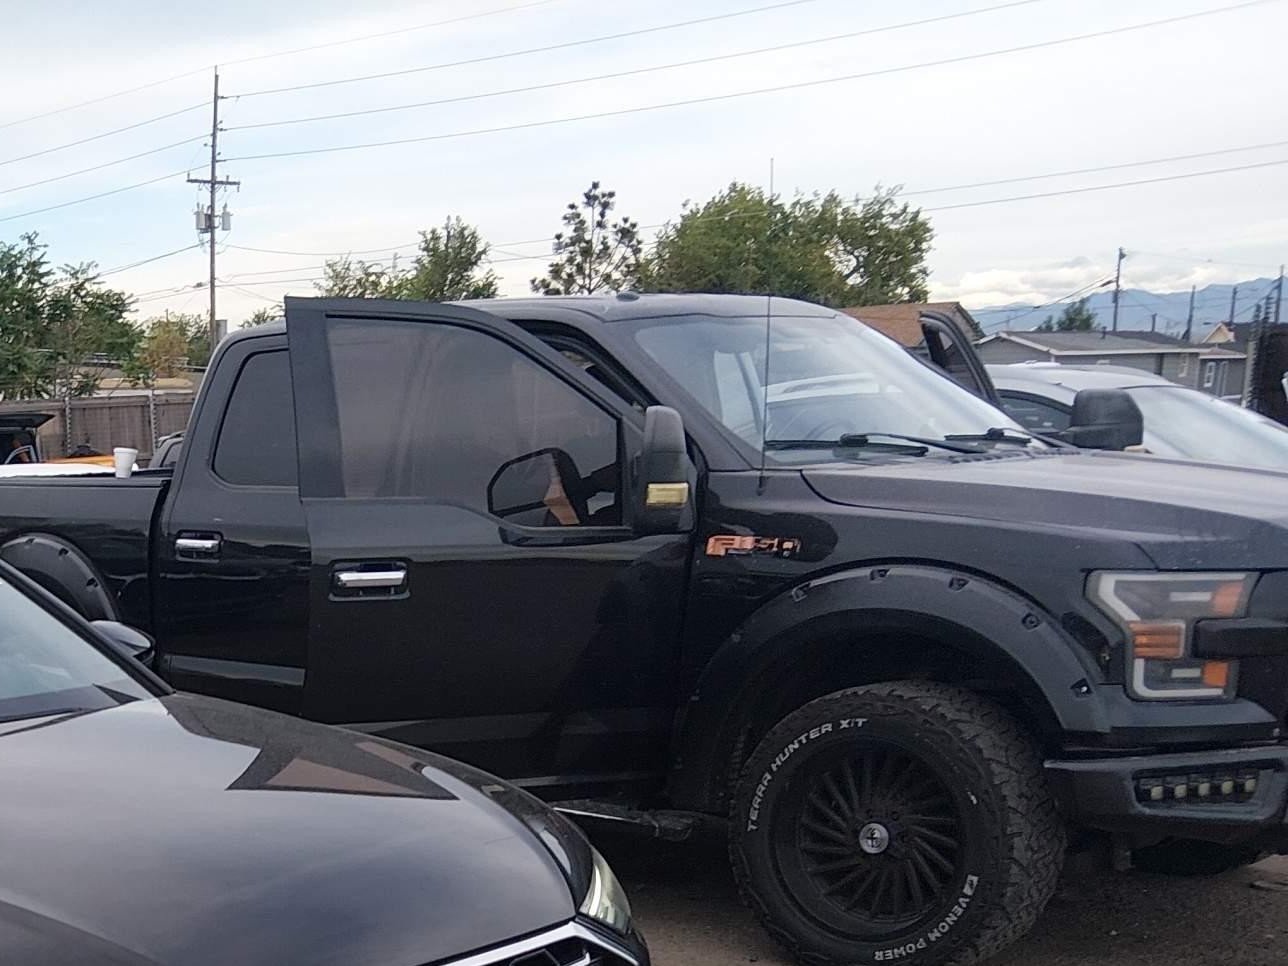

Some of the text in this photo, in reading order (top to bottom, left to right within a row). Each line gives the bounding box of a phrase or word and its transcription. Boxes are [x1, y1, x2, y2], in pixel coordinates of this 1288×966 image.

[747, 772, 772, 832] TERRA
[771, 722, 833, 772] HUNTER
[874, 897, 971, 960] VENOM POWER
